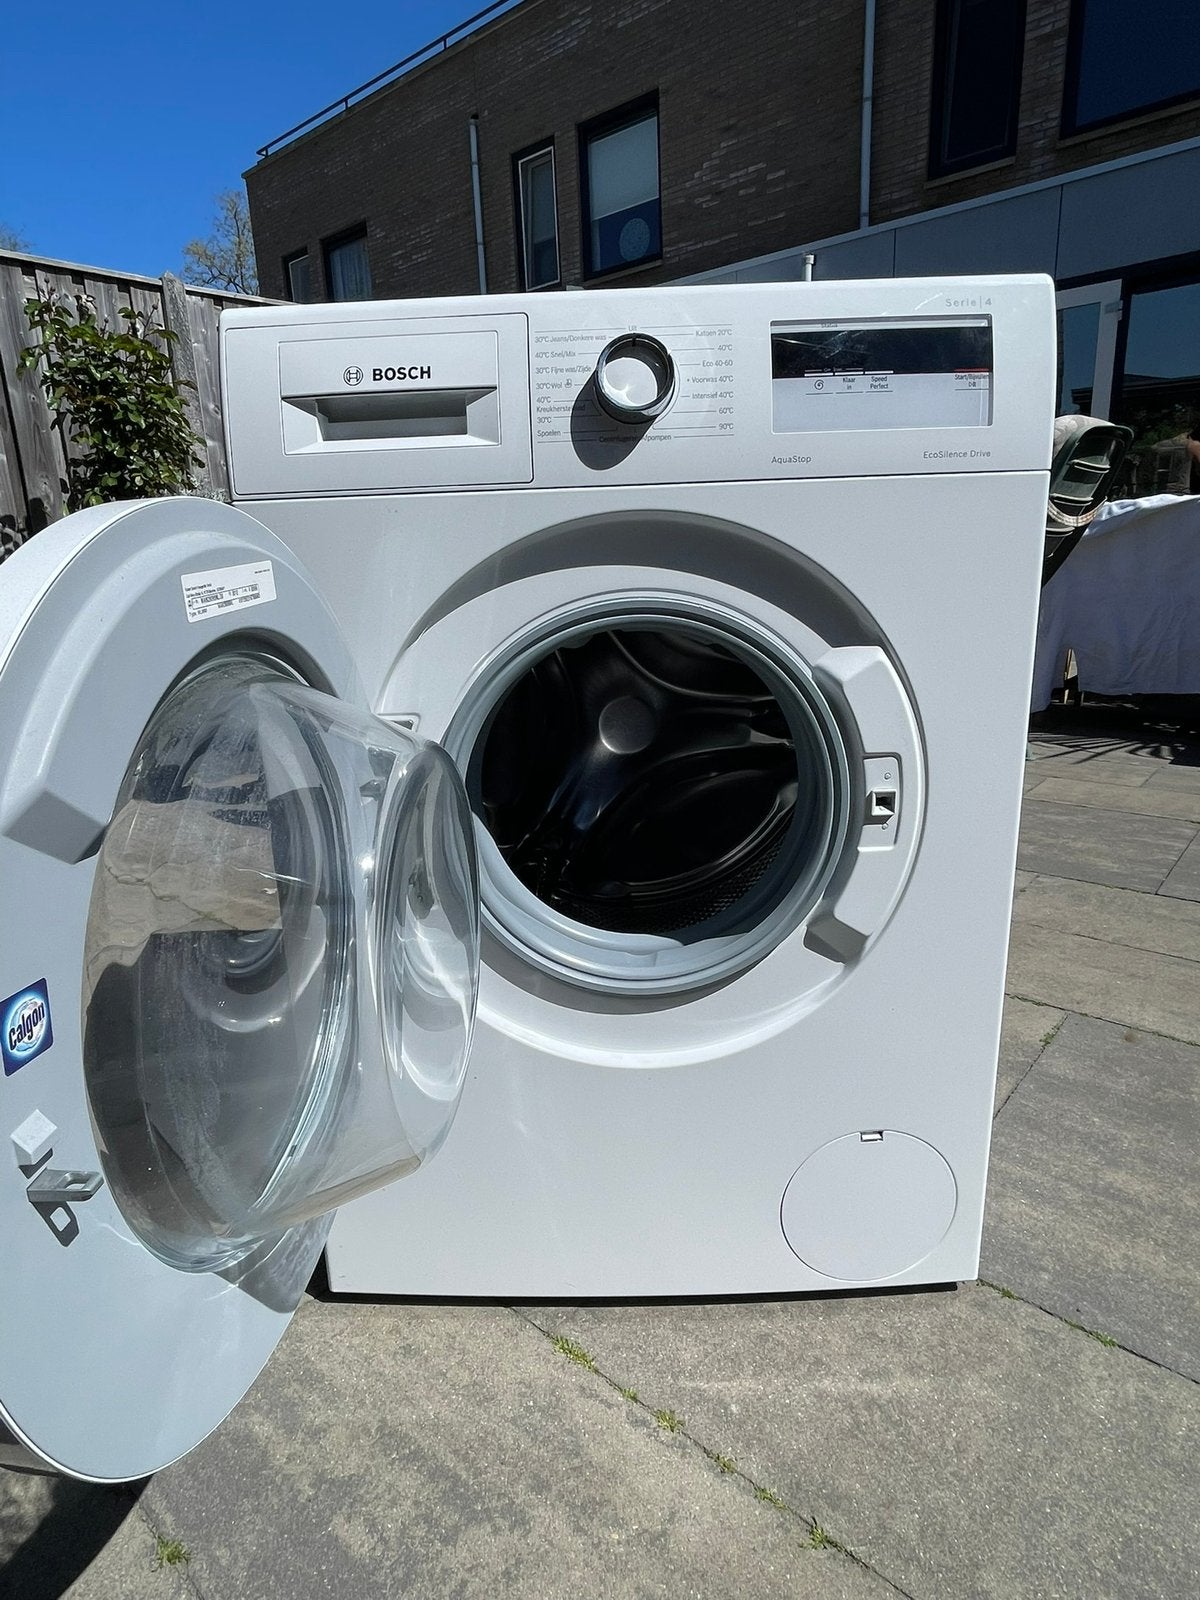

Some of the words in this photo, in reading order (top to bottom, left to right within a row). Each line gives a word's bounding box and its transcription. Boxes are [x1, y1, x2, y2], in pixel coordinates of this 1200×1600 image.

[945, 298, 977, 307] Serie
[550, 350, 576, 358] Snel/Mix
[715, 359, 733, 367] 40-60
[372, 365, 431, 382] BOSCH
[692, 391, 718, 399] Intensief
[537, 429, 561, 437] Spoelen
[923, 450, 968, 459] EcoSilence
[970, 449, 991, 458] Drive
[771, 455, 812, 465] AquaStop
[8, 1002, 46, 1051] Calgon
